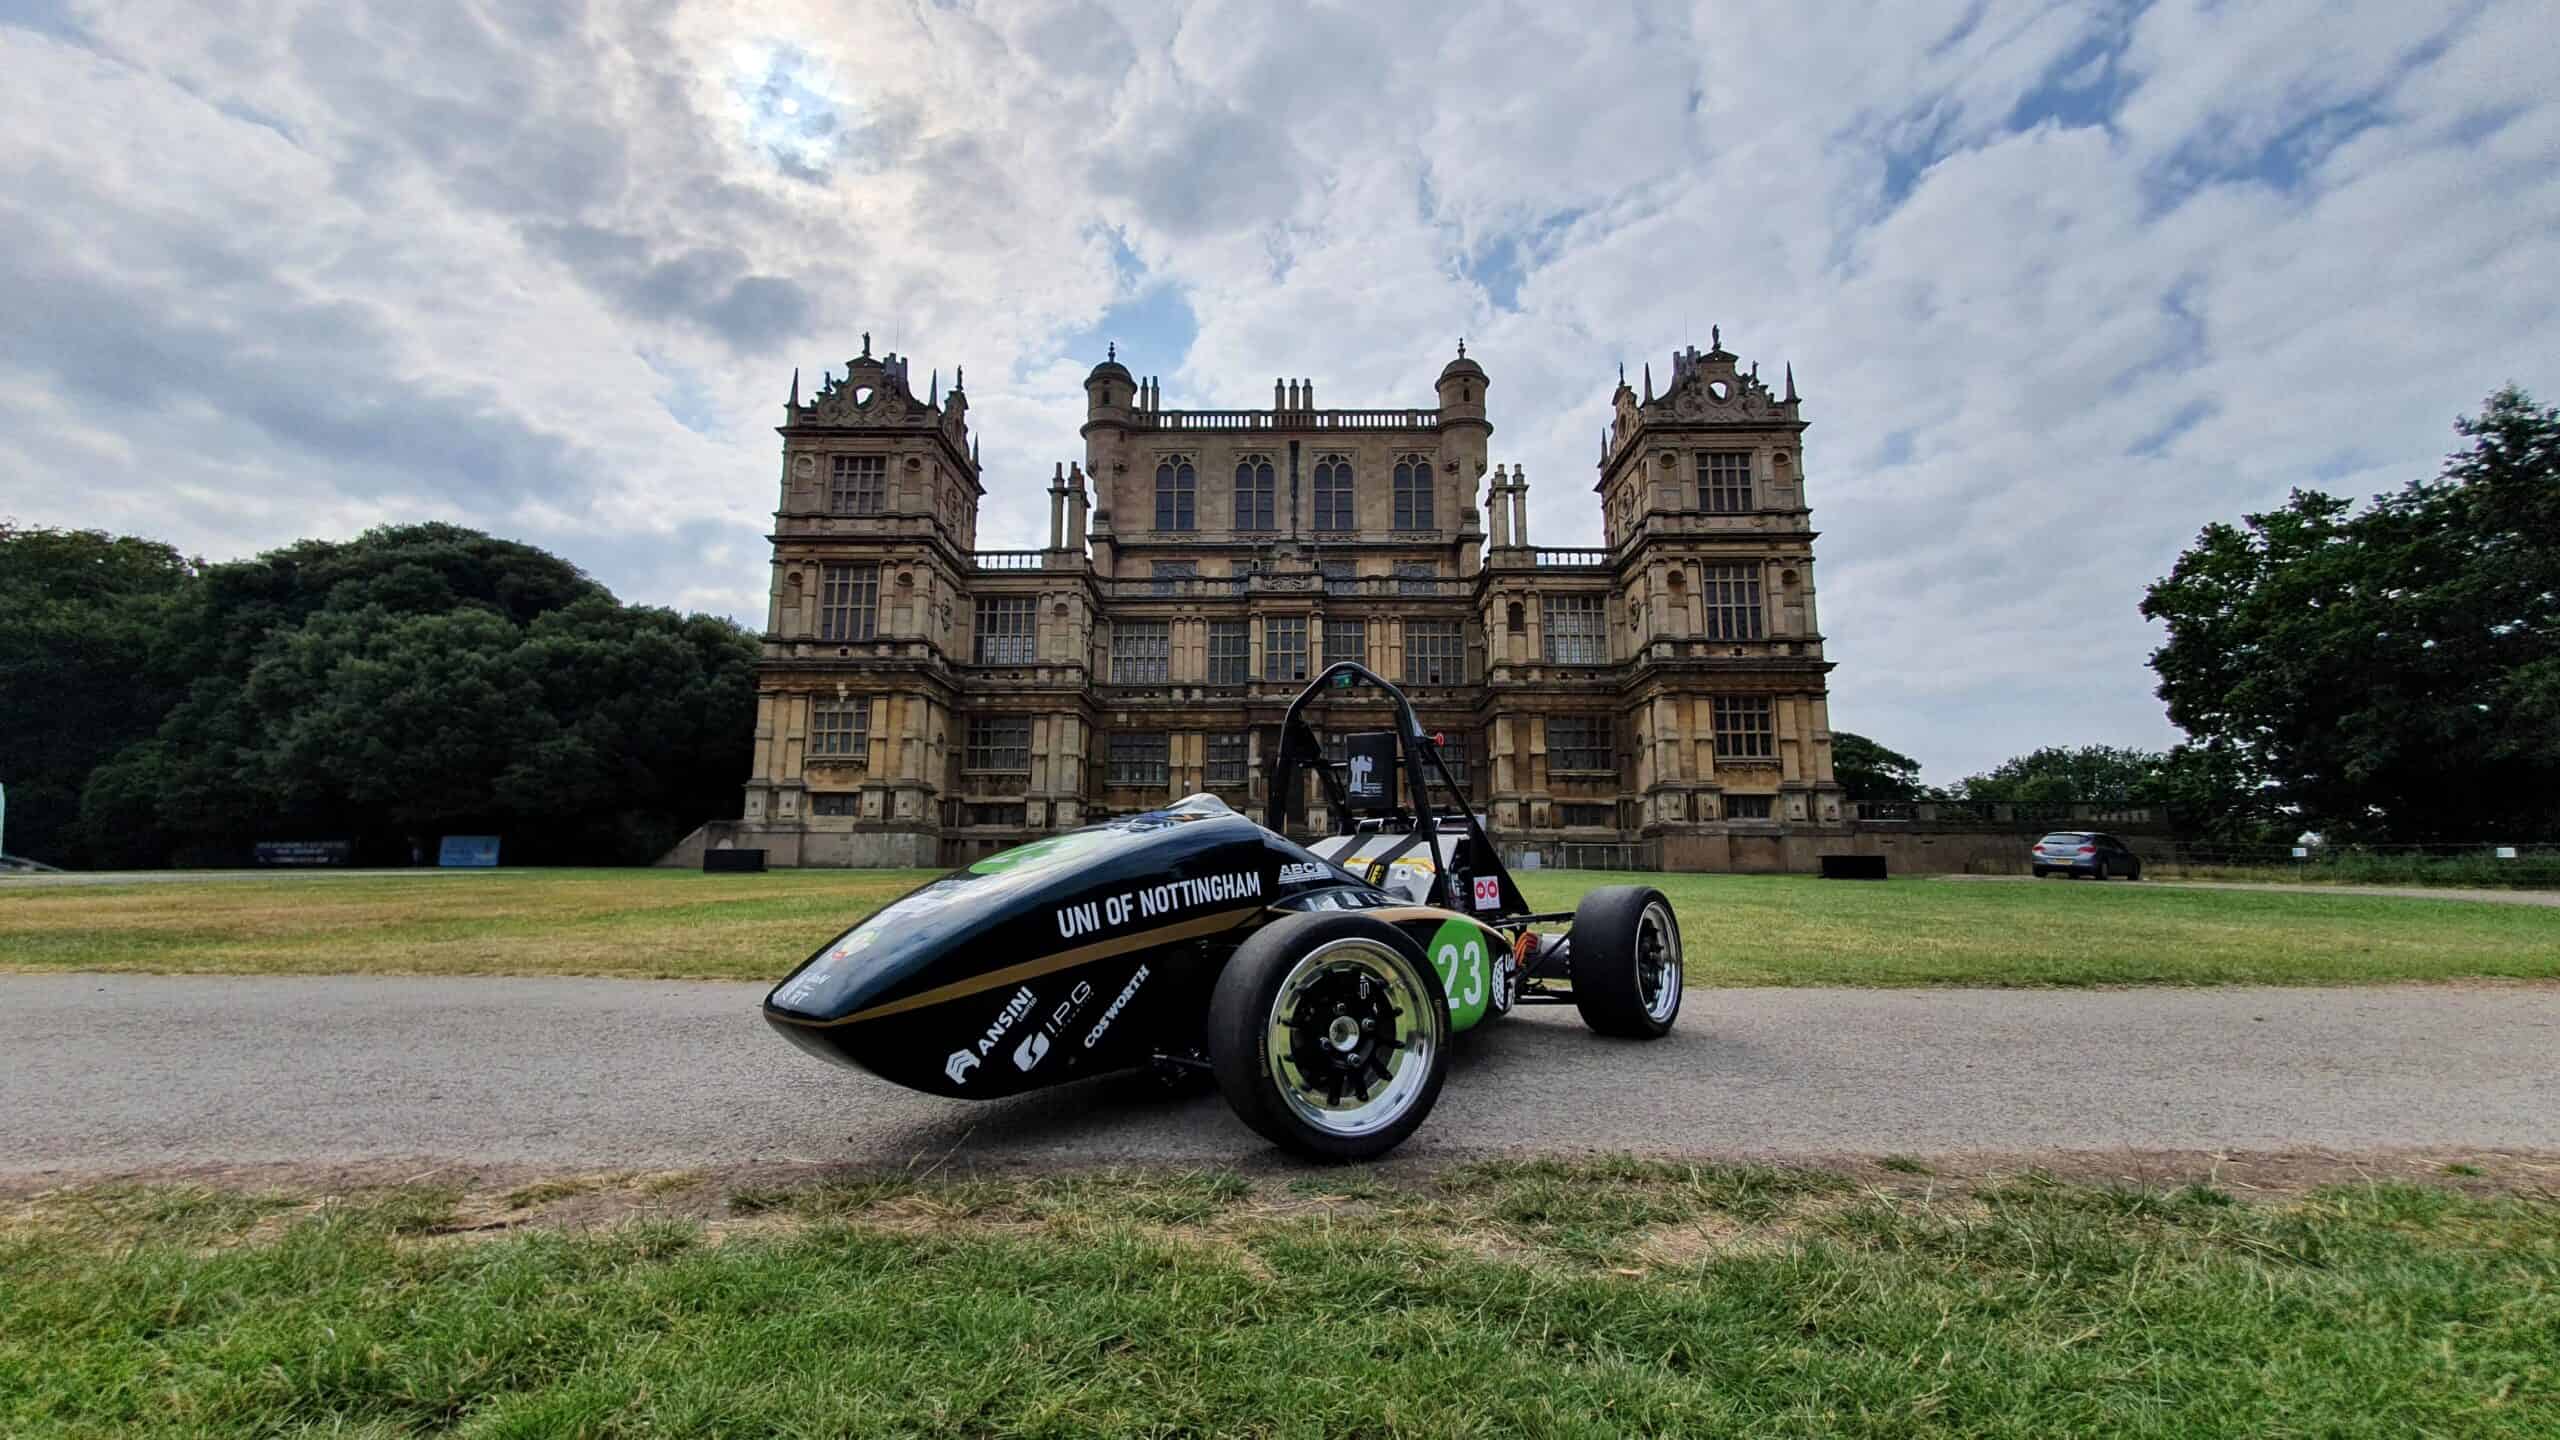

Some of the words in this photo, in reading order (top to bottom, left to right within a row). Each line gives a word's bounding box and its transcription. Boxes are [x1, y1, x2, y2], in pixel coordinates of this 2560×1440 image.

[1057, 903, 1101, 938] UNI
[1106, 893, 1134, 926] OF
[1139, 871, 1262, 918] NOTTINGHAM
[1046, 980, 1091, 1034] IPG
[1084, 963, 1150, 1048] COSWORTH
[1438, 941, 1481, 1009] 23
[978, 986, 1033, 1056] ANSINI
